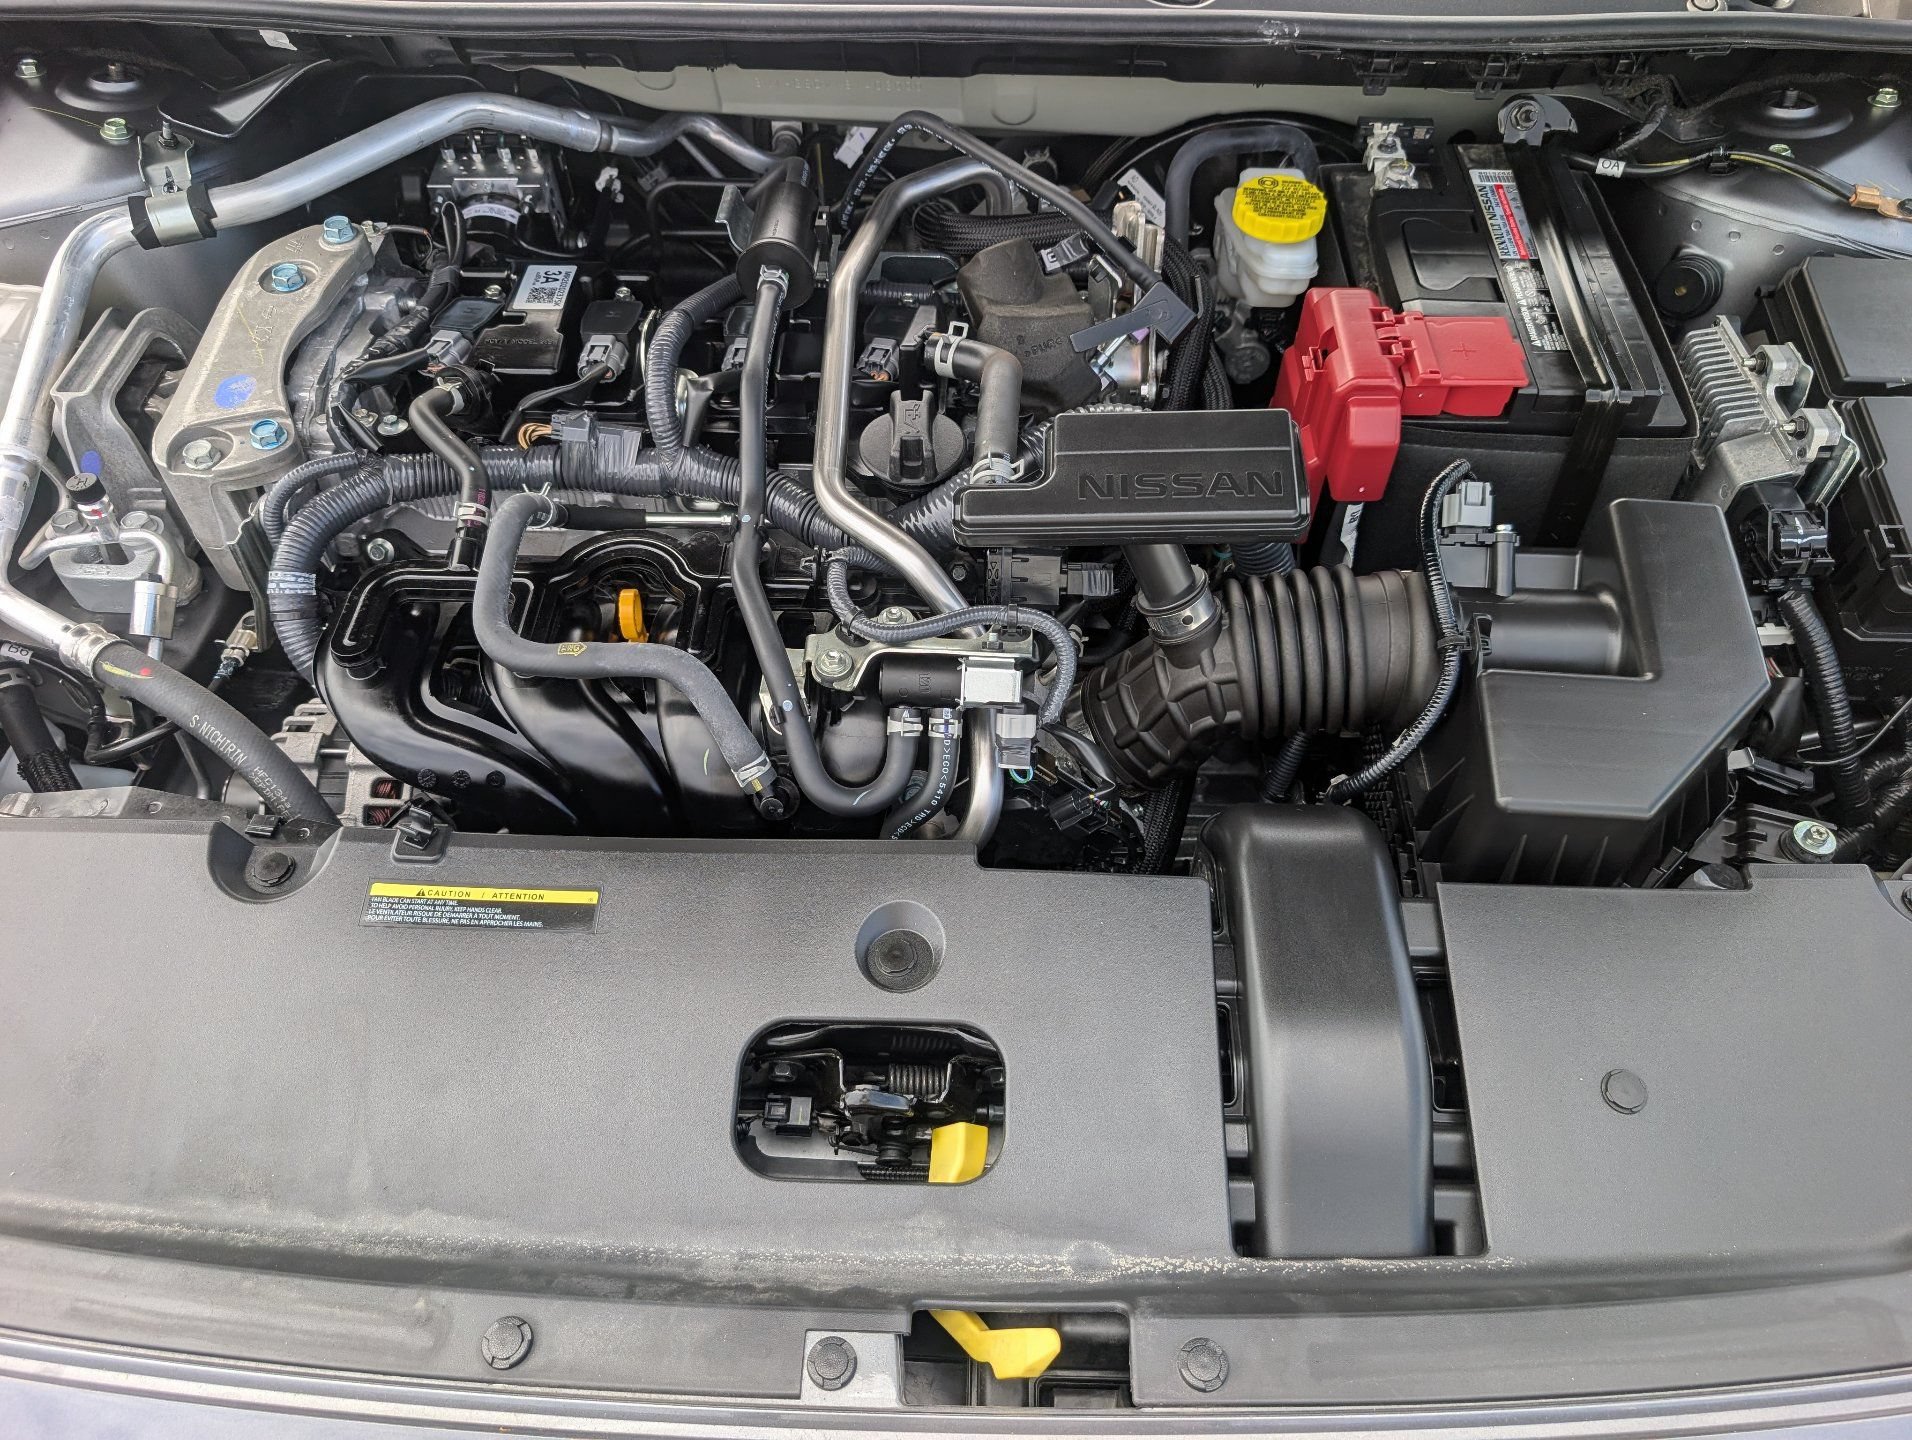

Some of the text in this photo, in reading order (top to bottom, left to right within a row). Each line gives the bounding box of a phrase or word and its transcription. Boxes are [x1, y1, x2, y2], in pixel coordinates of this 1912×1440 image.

[1477, 185, 1498, 221] NISSAN
[1490, 223, 1511, 257] RENAULT
[541, 270, 562, 285] 3A
[1078, 471, 1283, 500] NISSAN
[427, 890, 471, 898] CAUTION
[491, 892, 545, 901] ATTENTION
[376, 908, 413, 916] VENTILATEUR
